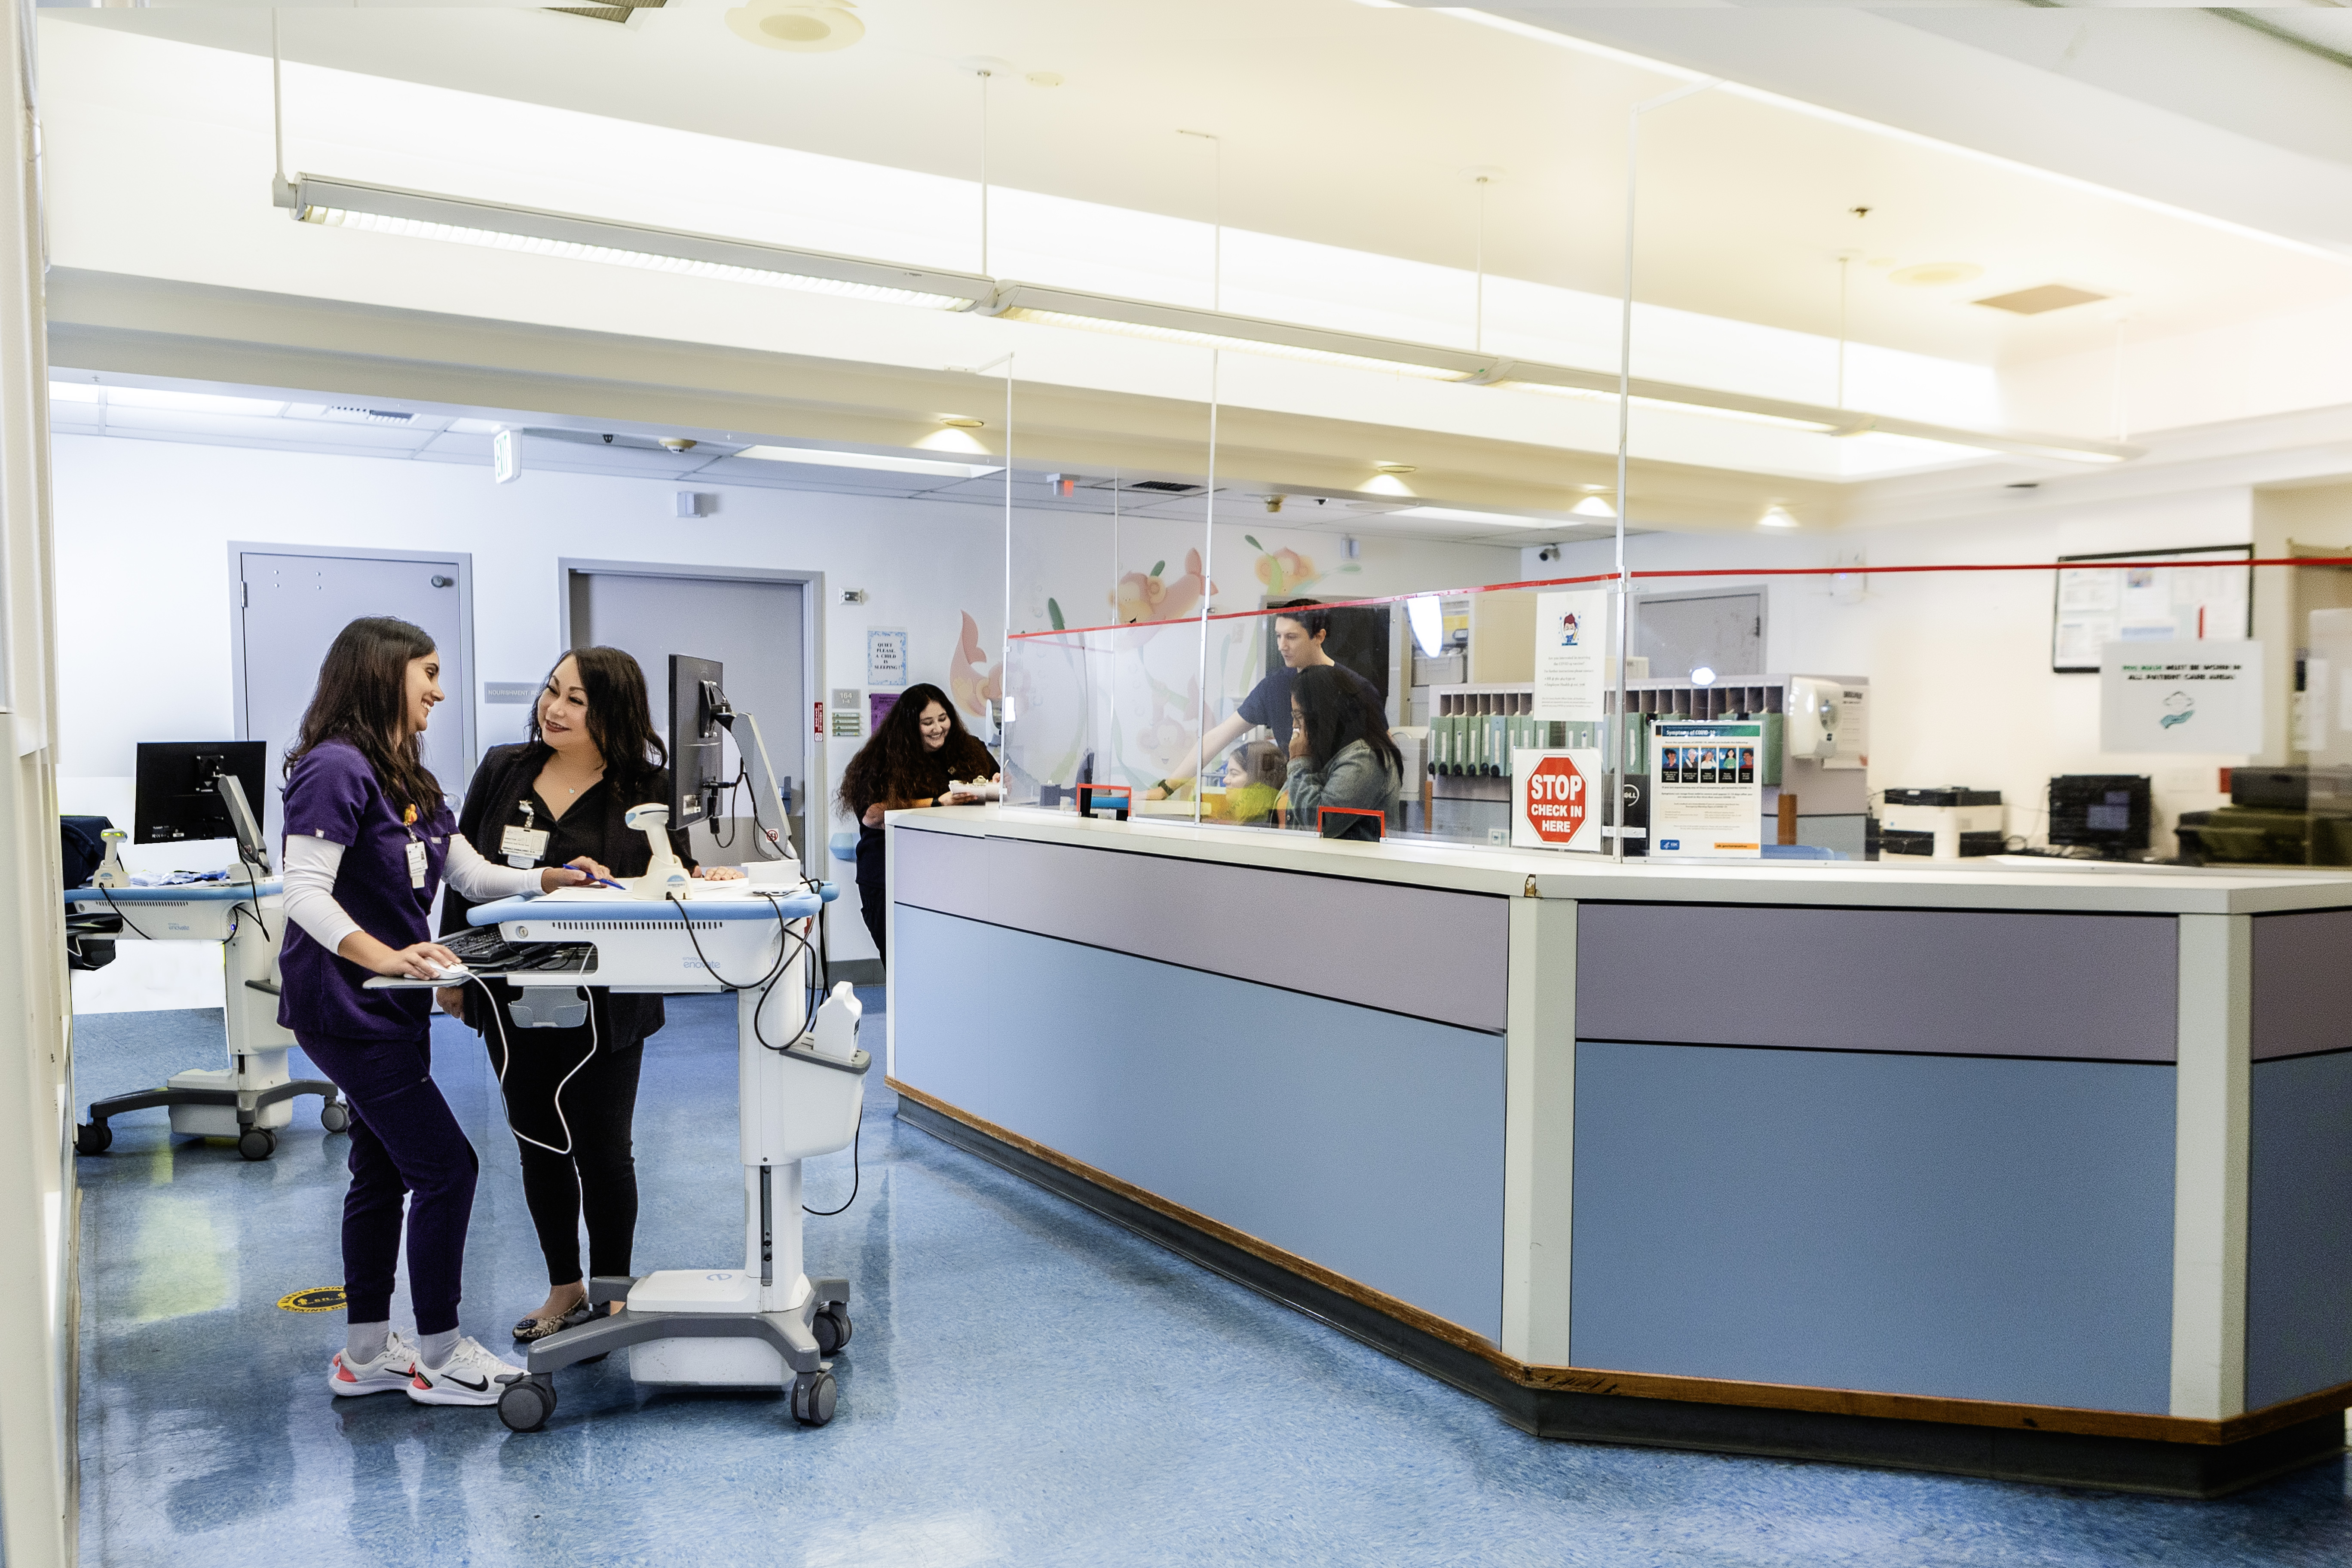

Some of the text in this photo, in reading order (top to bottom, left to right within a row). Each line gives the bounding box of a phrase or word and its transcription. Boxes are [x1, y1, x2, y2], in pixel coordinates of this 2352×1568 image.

[496, 435, 508, 477] EXIT
[1531, 774, 1582, 800] STOP
[1531, 804, 1582, 818] CHECK IN
[1542, 820, 1571, 833] HERE
